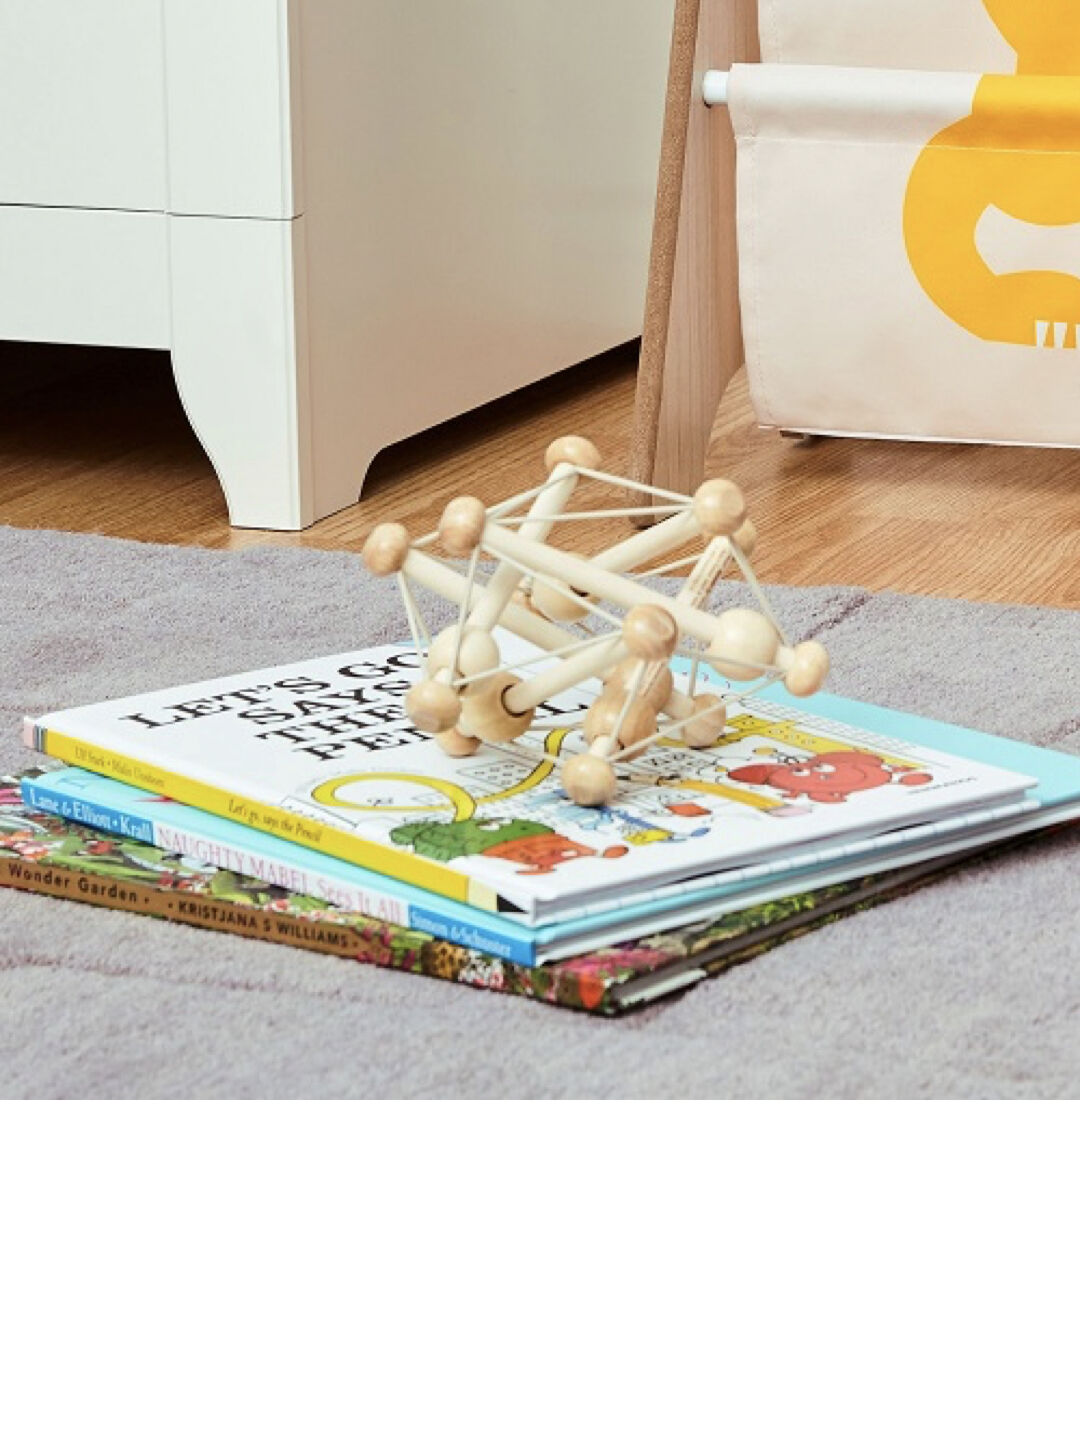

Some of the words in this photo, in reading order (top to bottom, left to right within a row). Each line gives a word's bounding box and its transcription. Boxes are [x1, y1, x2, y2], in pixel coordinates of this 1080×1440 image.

[118, 676, 331, 729] LET'S
[254, 704, 408, 744] THE
[158, 824, 246, 875] NAUGHTY
[250, 855, 307, 895] MABEL
[8, 862, 70, 889] Wonder
[77, 876, 137, 904] Garden
[178, 900, 258, 929] KRISTJANA
[263, 917, 271, 933] S
[276, 920, 348, 948] WILLIAMS
